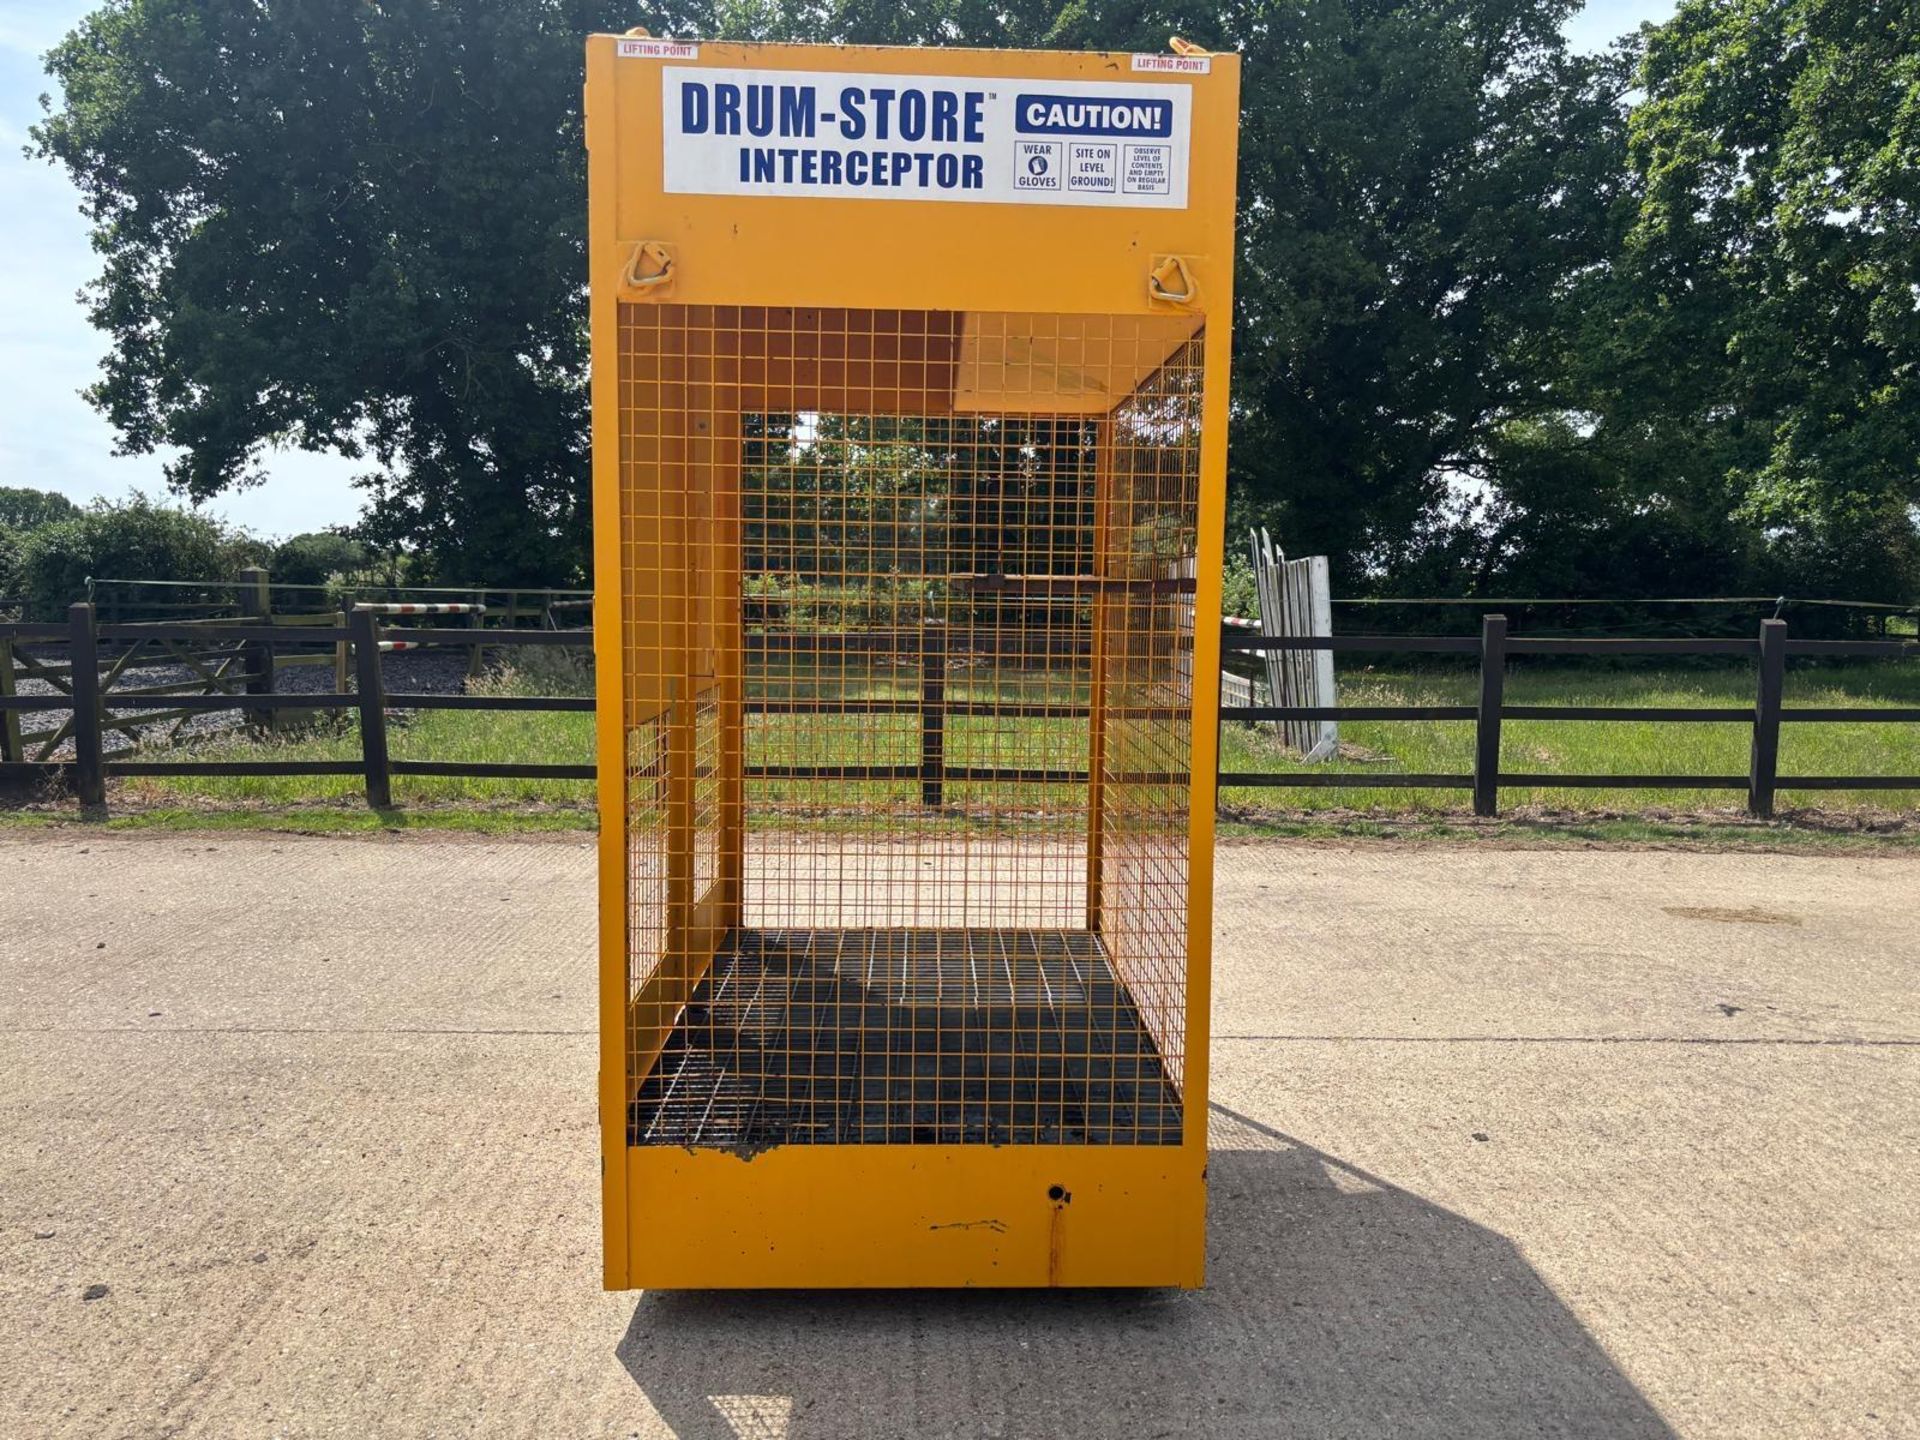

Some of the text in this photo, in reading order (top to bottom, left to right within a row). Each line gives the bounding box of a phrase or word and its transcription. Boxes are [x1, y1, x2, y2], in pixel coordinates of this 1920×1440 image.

[623, 44, 693, 56] LIFTING POINT
[1137, 58, 1204, 71] LIFTING POINT
[681, 82, 985, 143] DRUM-STORE
[1026, 103, 1162, 130] CAUTION!
[1023, 144, 1052, 155] WEAR
[1076, 148, 1111, 160] SITE ON
[1133, 147, 1161, 155] OBSERVE
[740, 147, 984, 189] INTERCEPTOR
[1080, 162, 1105, 173] LEVEL
[1019, 176, 1056, 187] GLOVES
[1071, 176, 1114, 187] GROUND!
